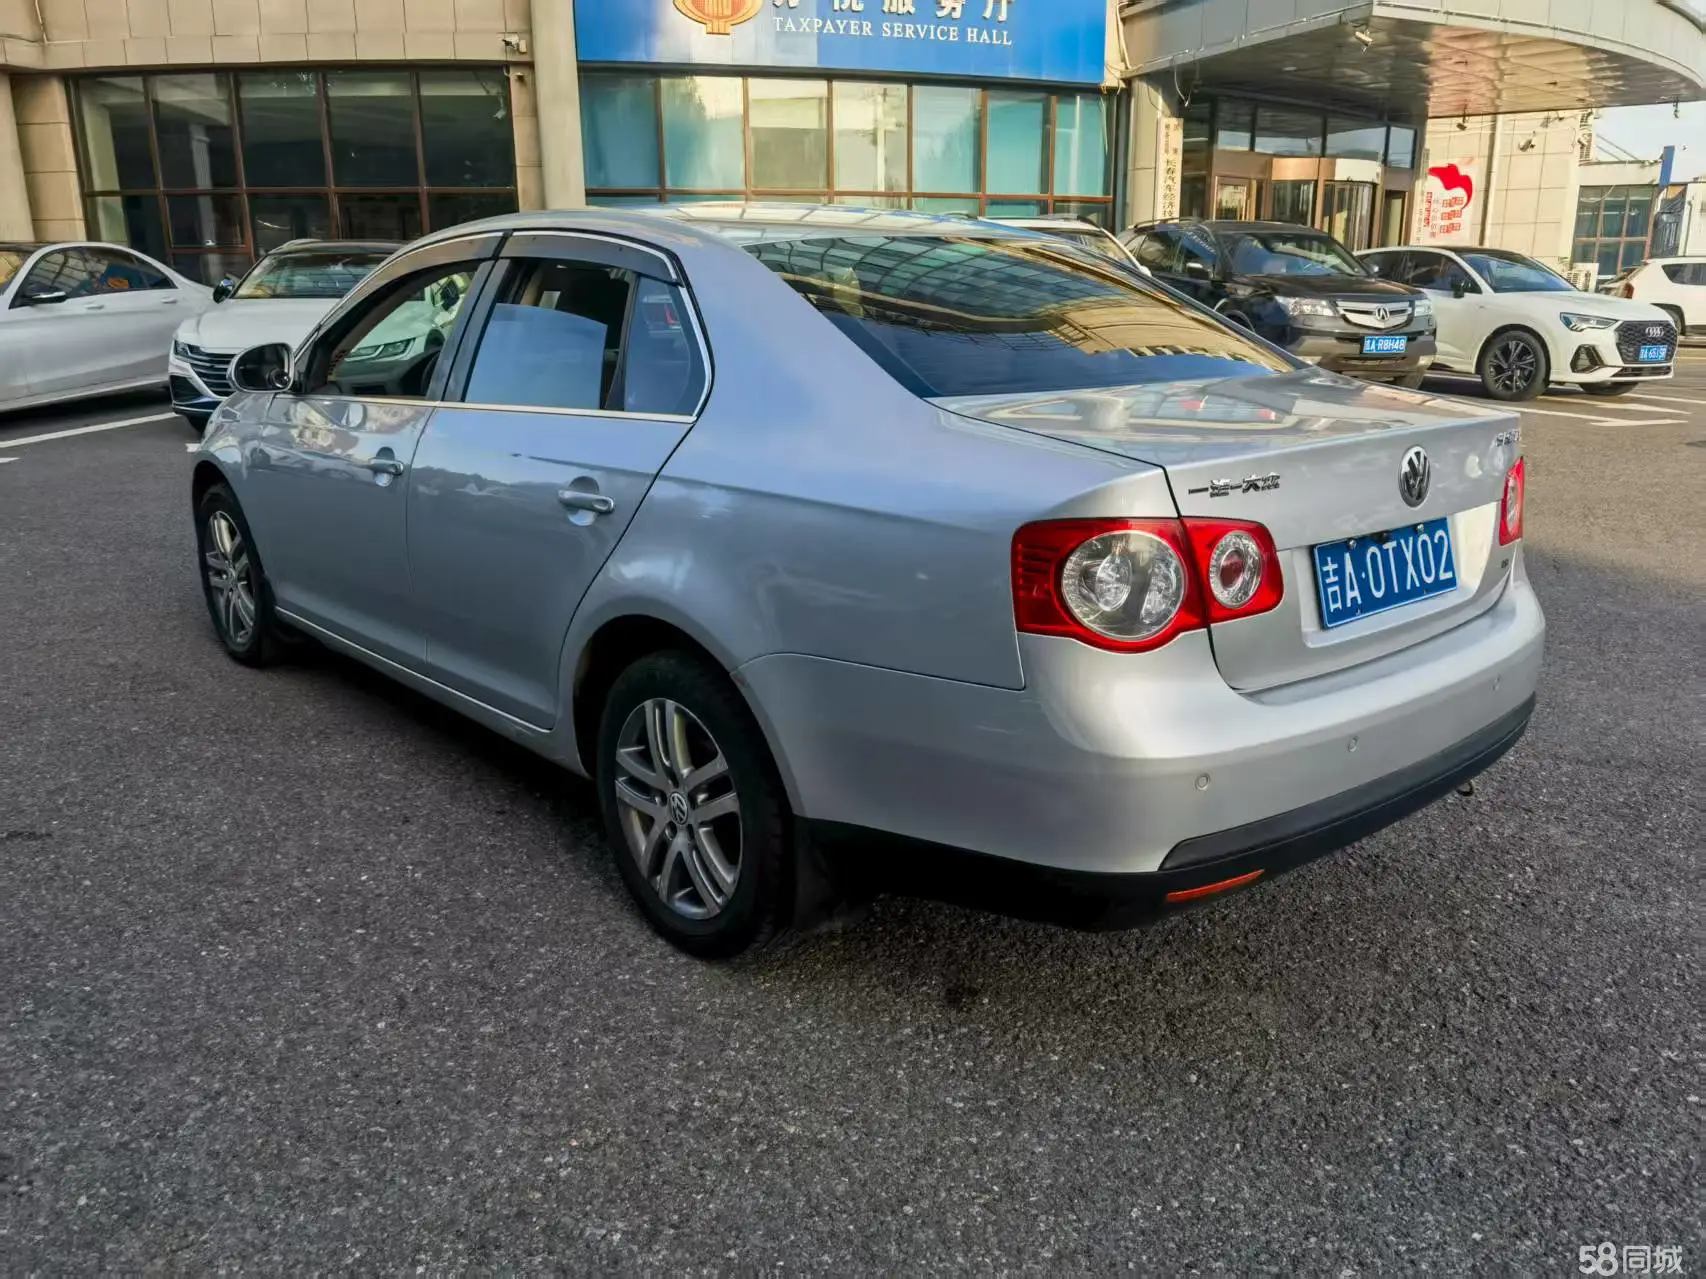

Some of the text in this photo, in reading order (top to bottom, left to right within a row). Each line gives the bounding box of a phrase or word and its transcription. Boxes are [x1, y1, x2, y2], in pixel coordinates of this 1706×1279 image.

[773, 16, 1012, 46] TAXPAYER SERVICE HALL
